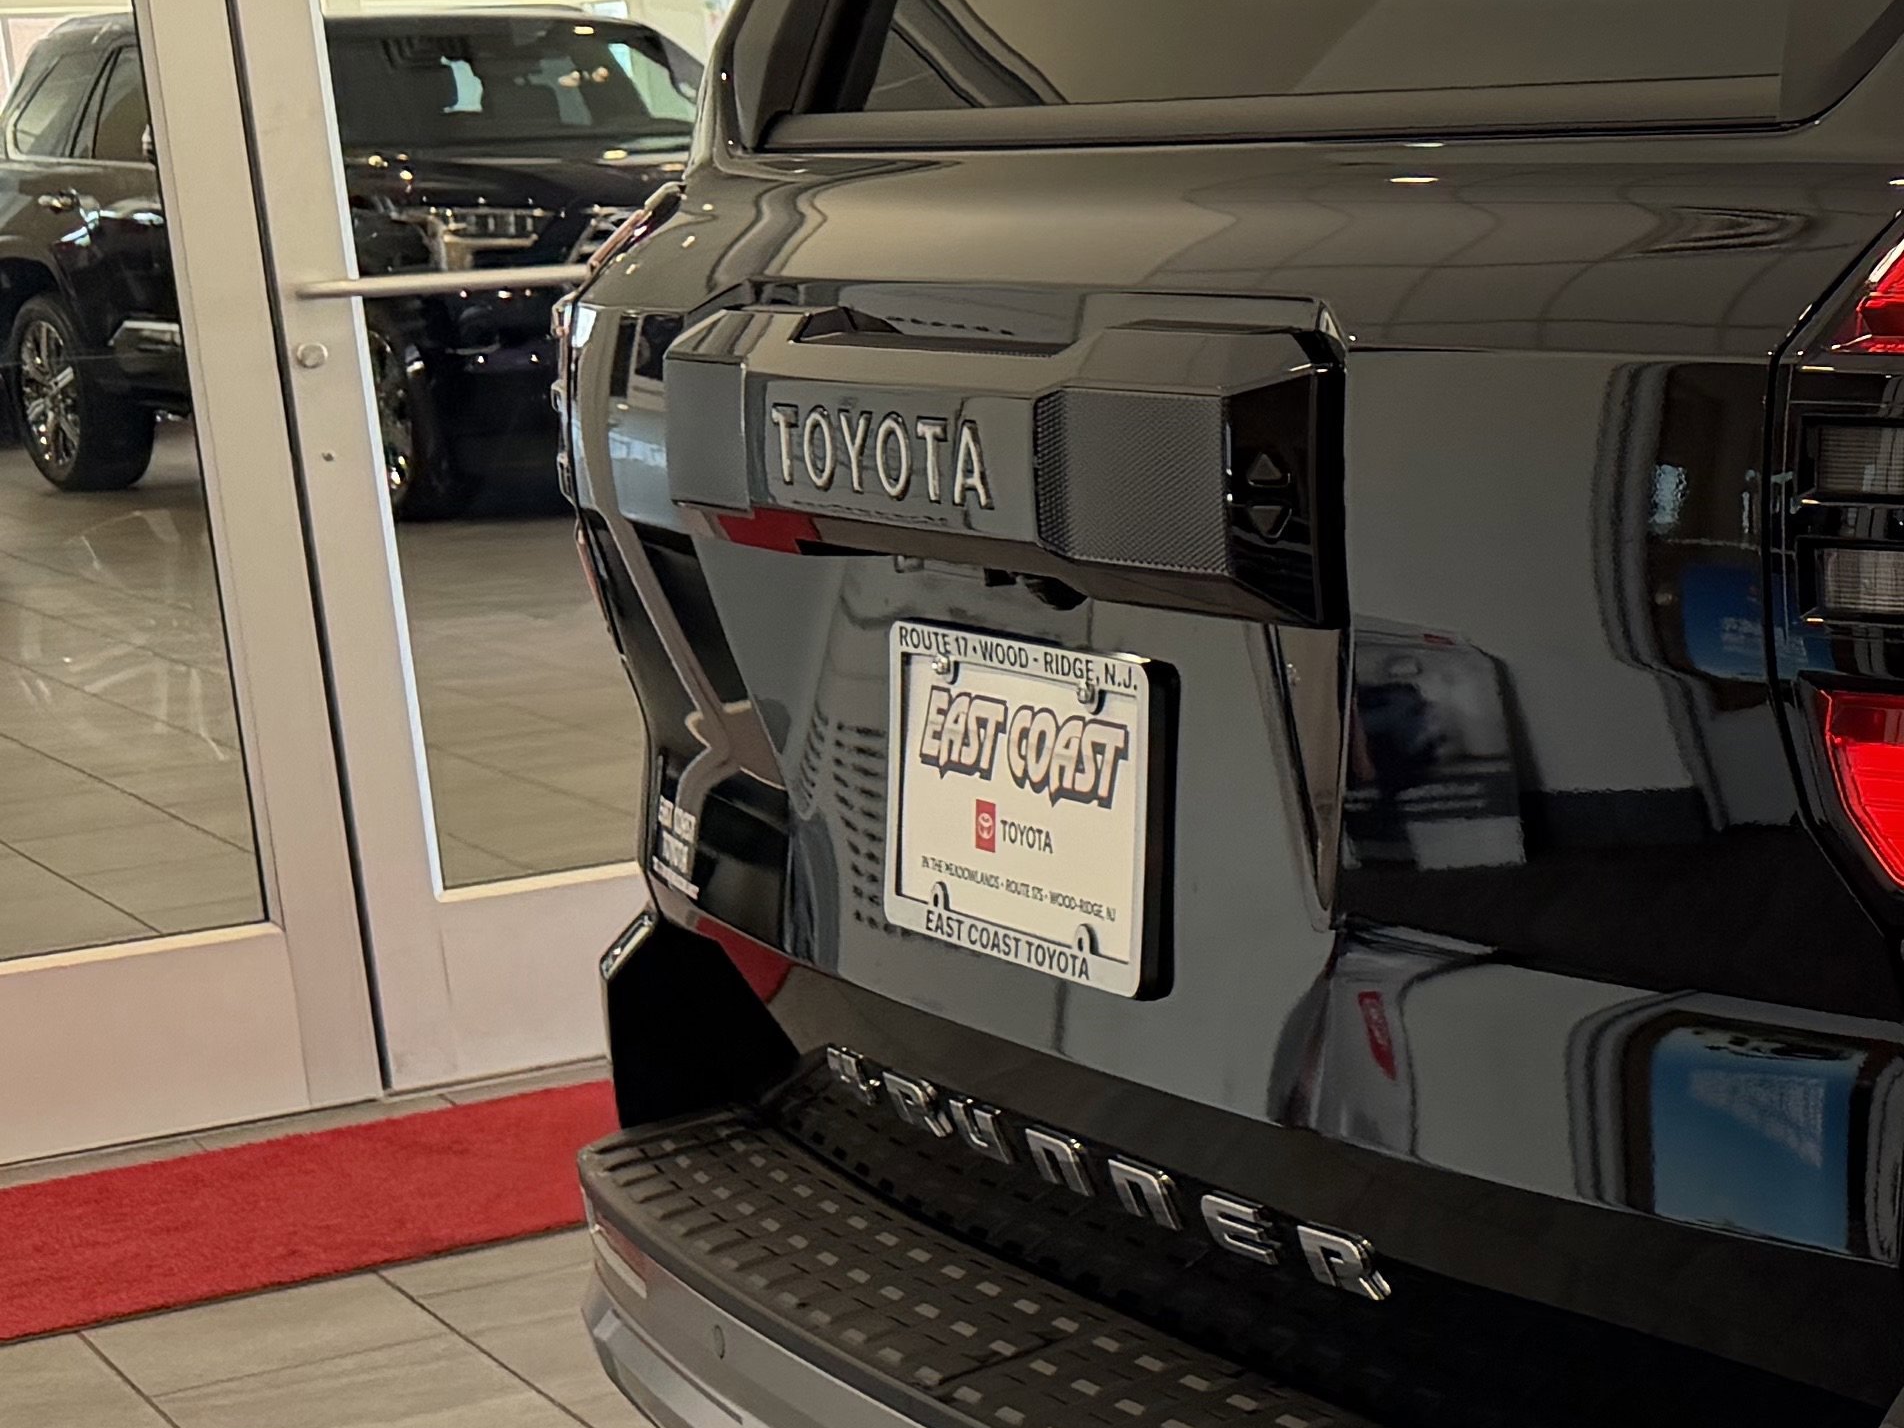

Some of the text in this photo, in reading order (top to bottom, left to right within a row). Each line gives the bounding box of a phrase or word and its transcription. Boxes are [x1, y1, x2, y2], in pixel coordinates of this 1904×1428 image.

[771, 402, 995, 510] TOYOTA
[899, 626, 951, 656] ROUTE
[955, 636, 969, 657] 17
[980, 640, 1029, 669] WOOD
[1104, 663, 1138, 691] N.J.
[919, 684, 1129, 810] EAST COAST
[1000, 819, 1054, 854] TOYOTA
[925, 909, 1091, 981] EAST COAST TOYOTA
